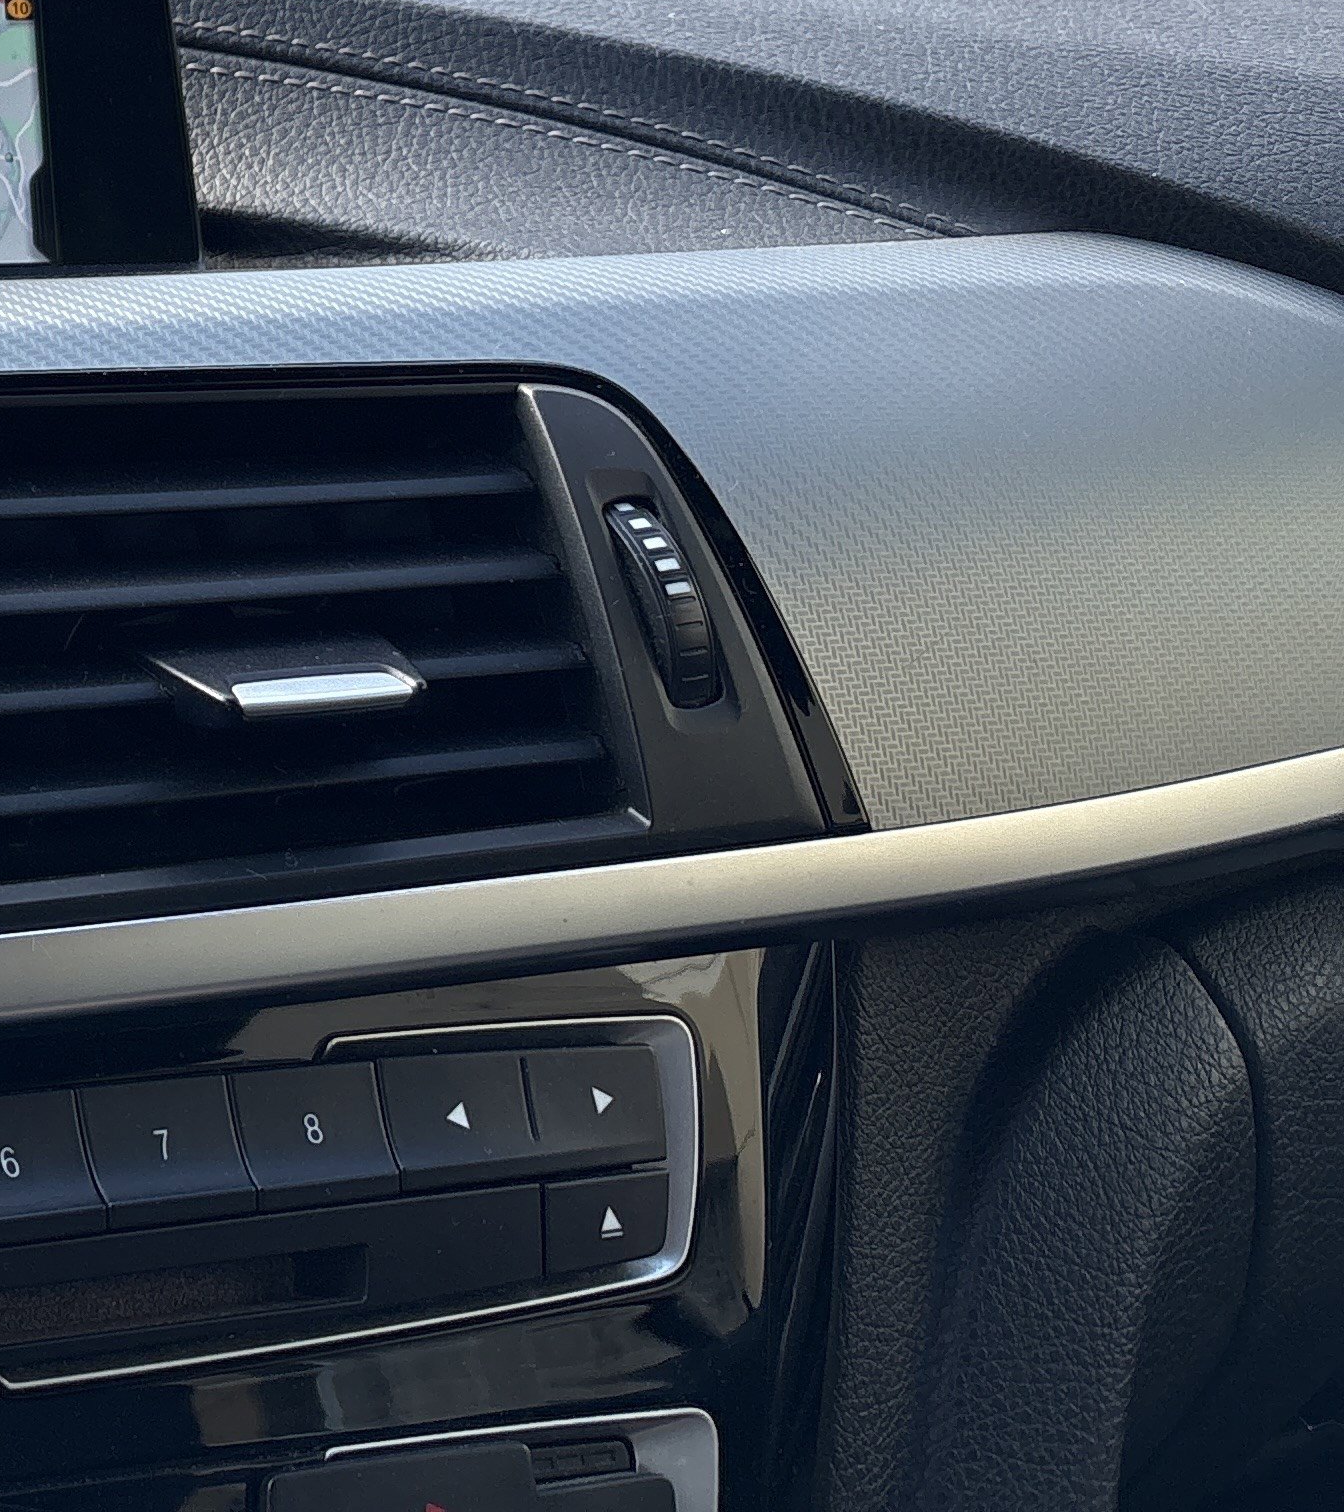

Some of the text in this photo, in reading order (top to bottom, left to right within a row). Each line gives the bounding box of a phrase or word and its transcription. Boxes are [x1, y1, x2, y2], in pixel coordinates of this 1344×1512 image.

[11, 0, 29, 16] 10
[153, 1129, 171, 1160] 7
[303, 1114, 324, 1145] 8
[0, 1146, 20, 1179] 6
